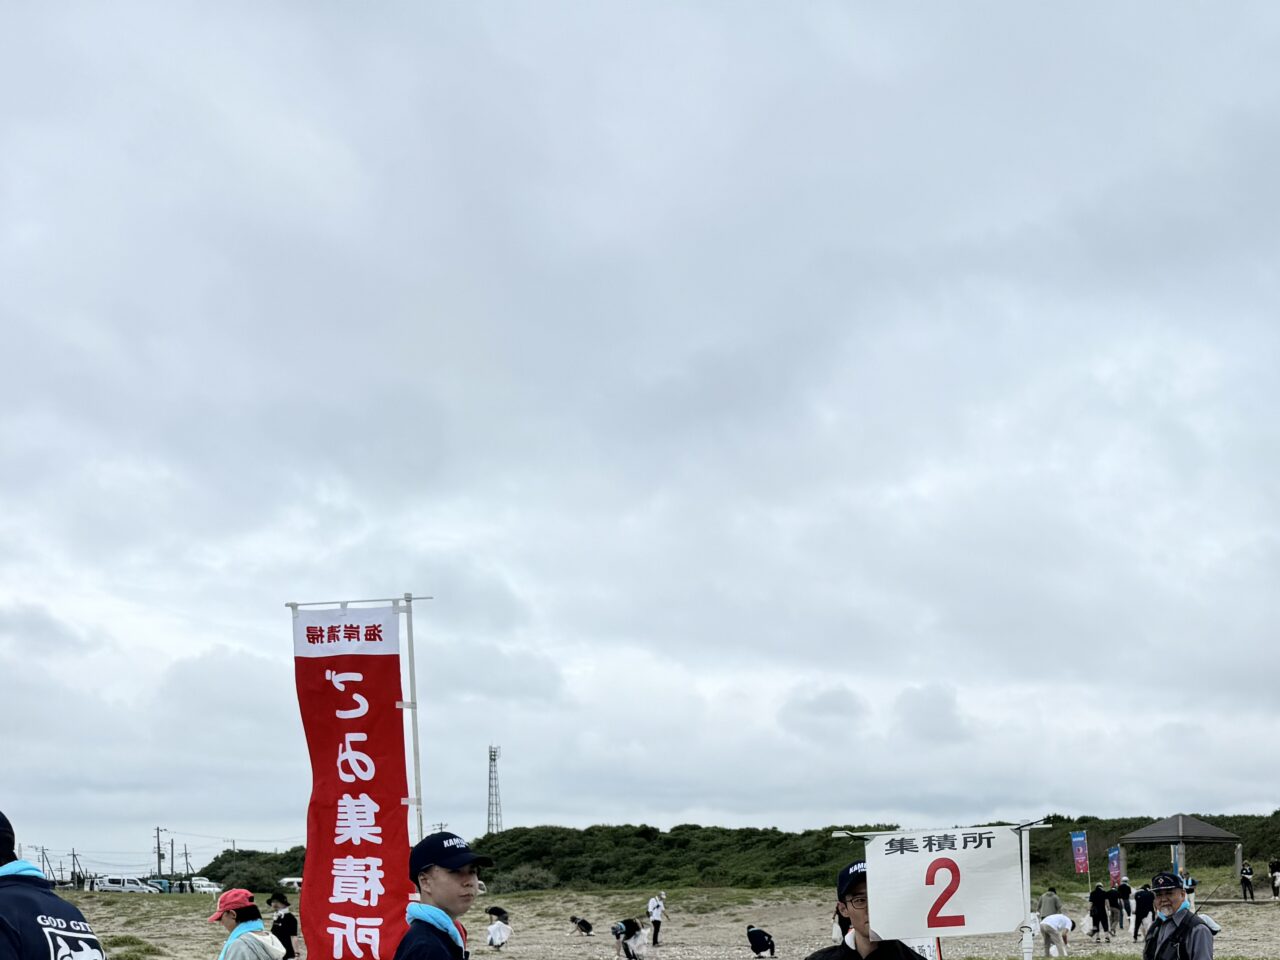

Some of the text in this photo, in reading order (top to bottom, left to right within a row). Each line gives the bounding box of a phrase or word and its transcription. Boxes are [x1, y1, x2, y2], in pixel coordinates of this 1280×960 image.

[884, 831, 996, 855] 集積所
[924, 857, 966, 928] 2
[36, 914, 67, 929] GOD
